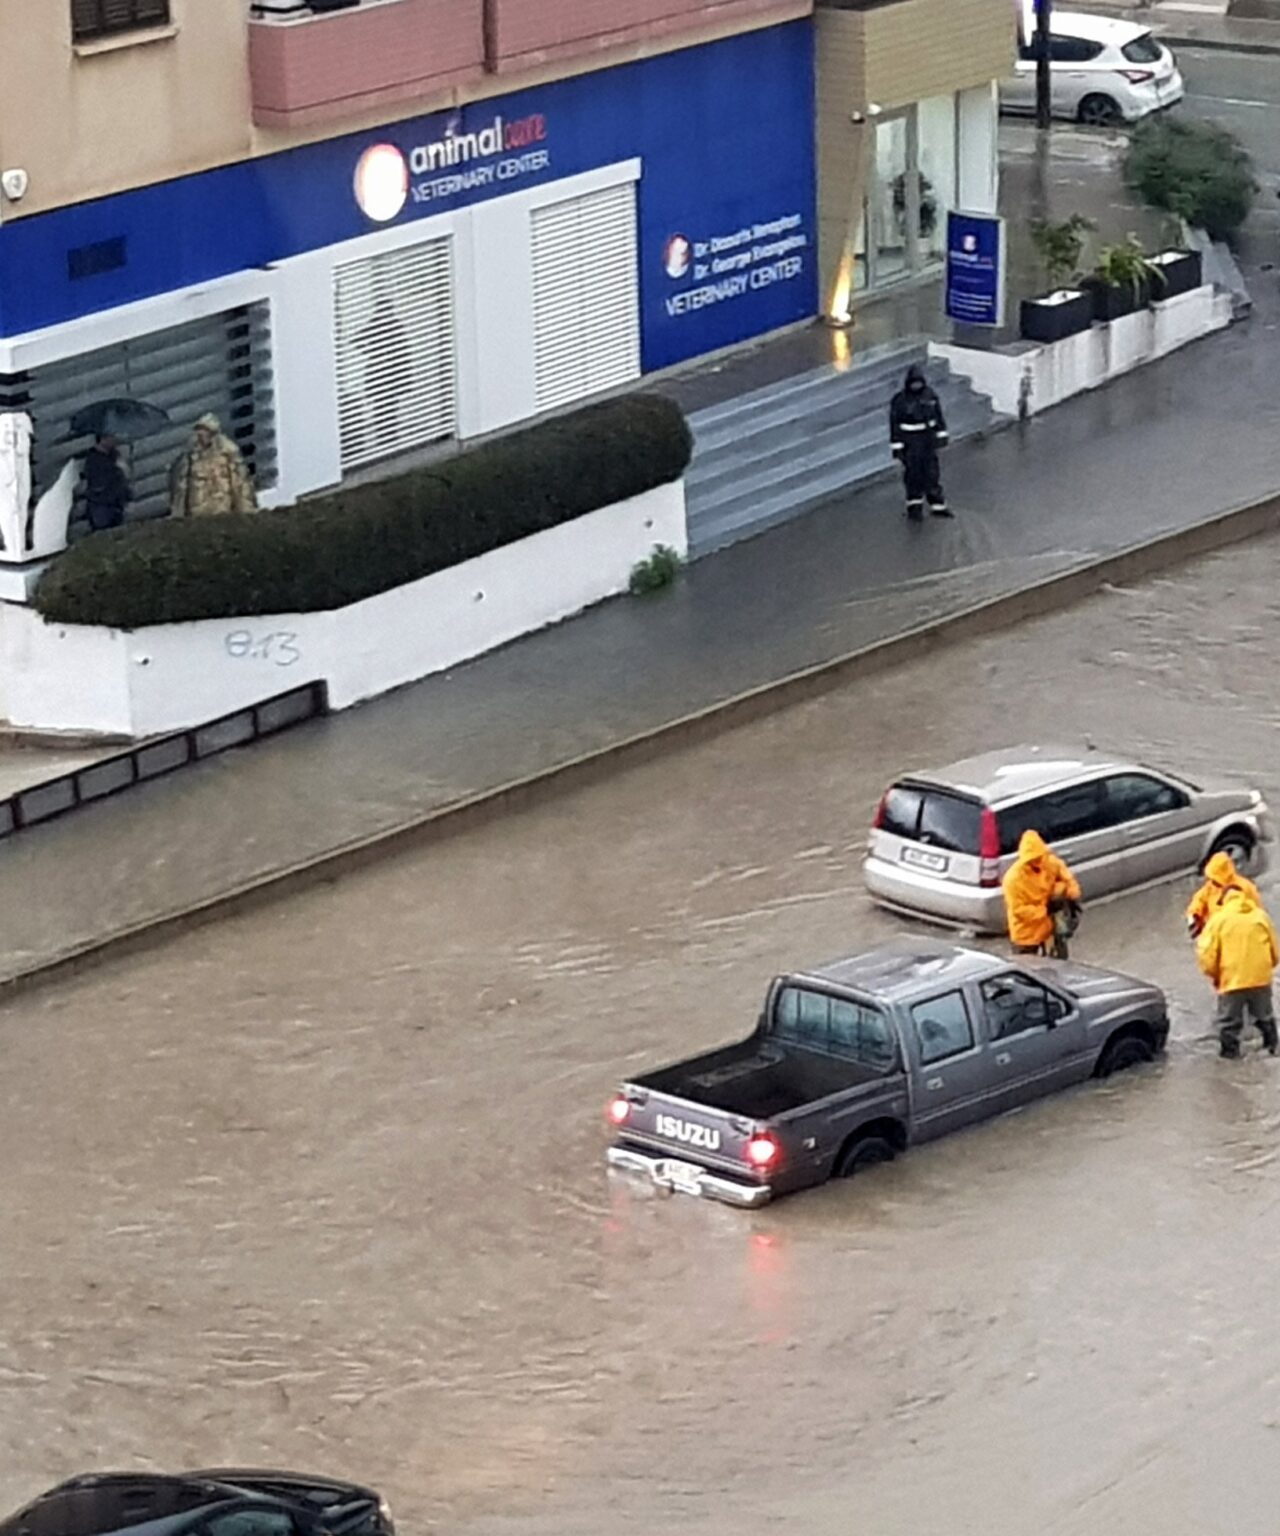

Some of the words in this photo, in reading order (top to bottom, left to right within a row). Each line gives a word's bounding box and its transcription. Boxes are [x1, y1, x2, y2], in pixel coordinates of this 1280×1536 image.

[411, 164, 495, 203] VETERINARY
[497, 150, 550, 180] CENTER
[666, 274, 748, 317] VETERINARY
[750, 256, 803, 289] CENTER
[656, 1114, 721, 1150] ISUZU
